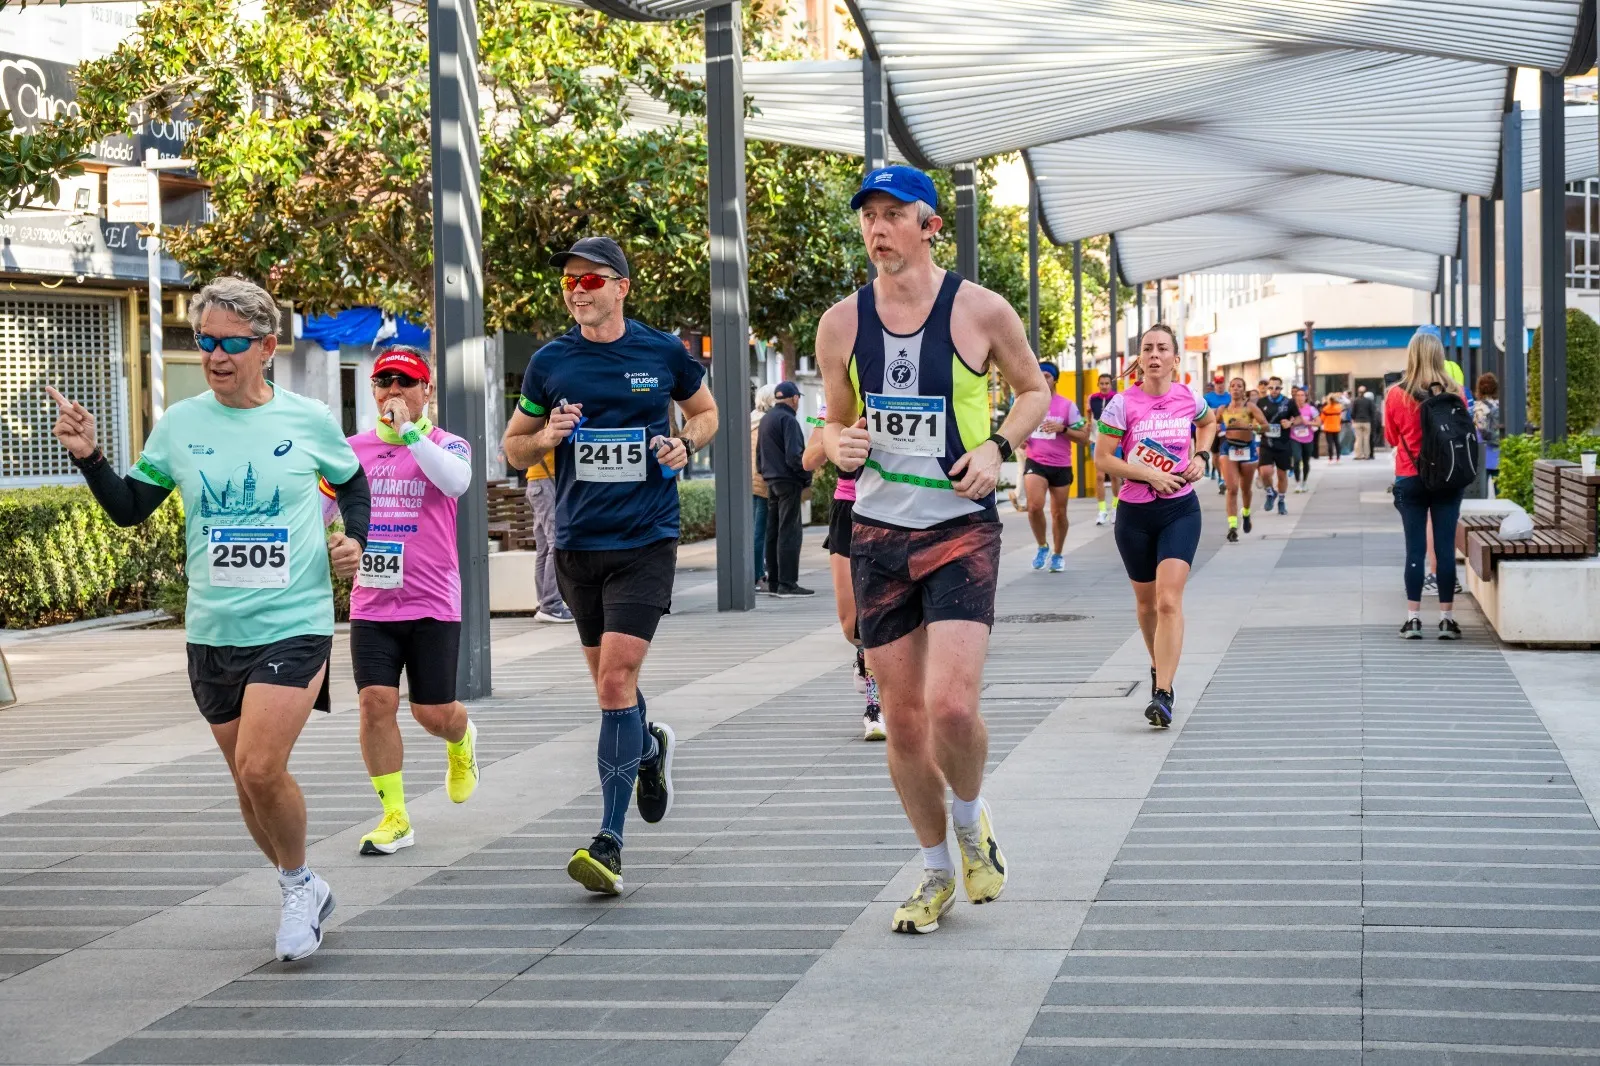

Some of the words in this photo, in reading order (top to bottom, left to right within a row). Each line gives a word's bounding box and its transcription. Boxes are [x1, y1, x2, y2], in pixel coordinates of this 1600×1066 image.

[871, 410, 937, 437] 1871
[579, 444, 643, 465] 2415
[1135, 445, 1174, 472] 1500
[366, 465, 397, 477] XXXVI
[371, 477, 427, 497] MARATÓN
[371, 496, 399, 508] CIONAL
[400, 497, 423, 509] 2026
[368, 523, 418, 533] EMOLINOS
[212, 544, 286, 568] 2505
[358, 553, 400, 574] 984
